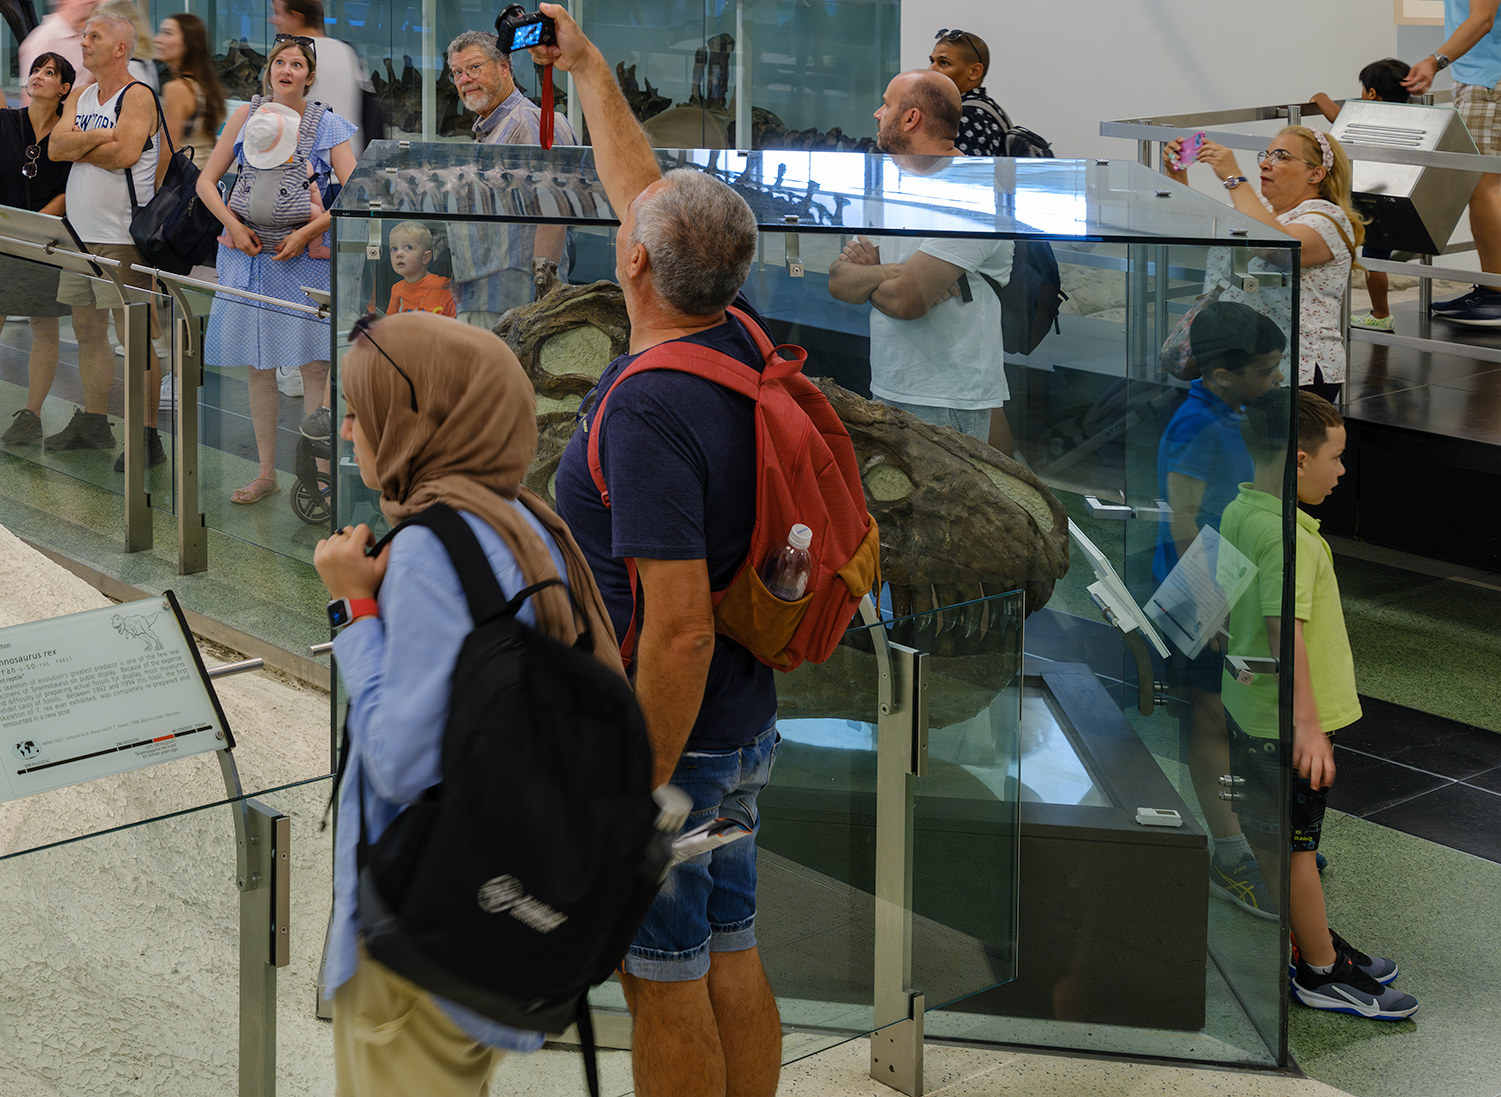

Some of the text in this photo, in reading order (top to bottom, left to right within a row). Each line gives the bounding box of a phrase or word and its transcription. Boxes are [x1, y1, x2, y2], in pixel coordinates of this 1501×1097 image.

[4, 682, 28, 691] skeleton
[38, 673, 68, 684] evolution's
[70, 667, 93, 678] greatest
[94, 662, 117, 672] predator
[8, 695, 34, 705] difficulty
[44, 687, 72, 698] preparing
[74, 682, 91, 690] actual
[92, 678, 110, 686] fossils
[122, 672, 142, 680] display,
[159, 662, 185, 671] museums
[31, 680, 69, 693] Tyrannosaurus
[79, 674, 96, 683] public
[97, 670, 116, 678] display.
[120, 664, 141, 673] Because
[161, 656, 182, 664] expense
[43, 696, 62, 704] fossils.
[66, 690, 90, 699] Between
[92, 685, 106, 693] 1992
[148, 673, 164, 681] fossil,
[0, 712, 25, 722] skeleton
[69, 695, 98, 706] exhibited,
[113, 685, 143, 696] completely
[145, 677, 178, 688] re-prepared
[2, 717, 33, 728] remounted
[57, 709, 71, 717] pose.
